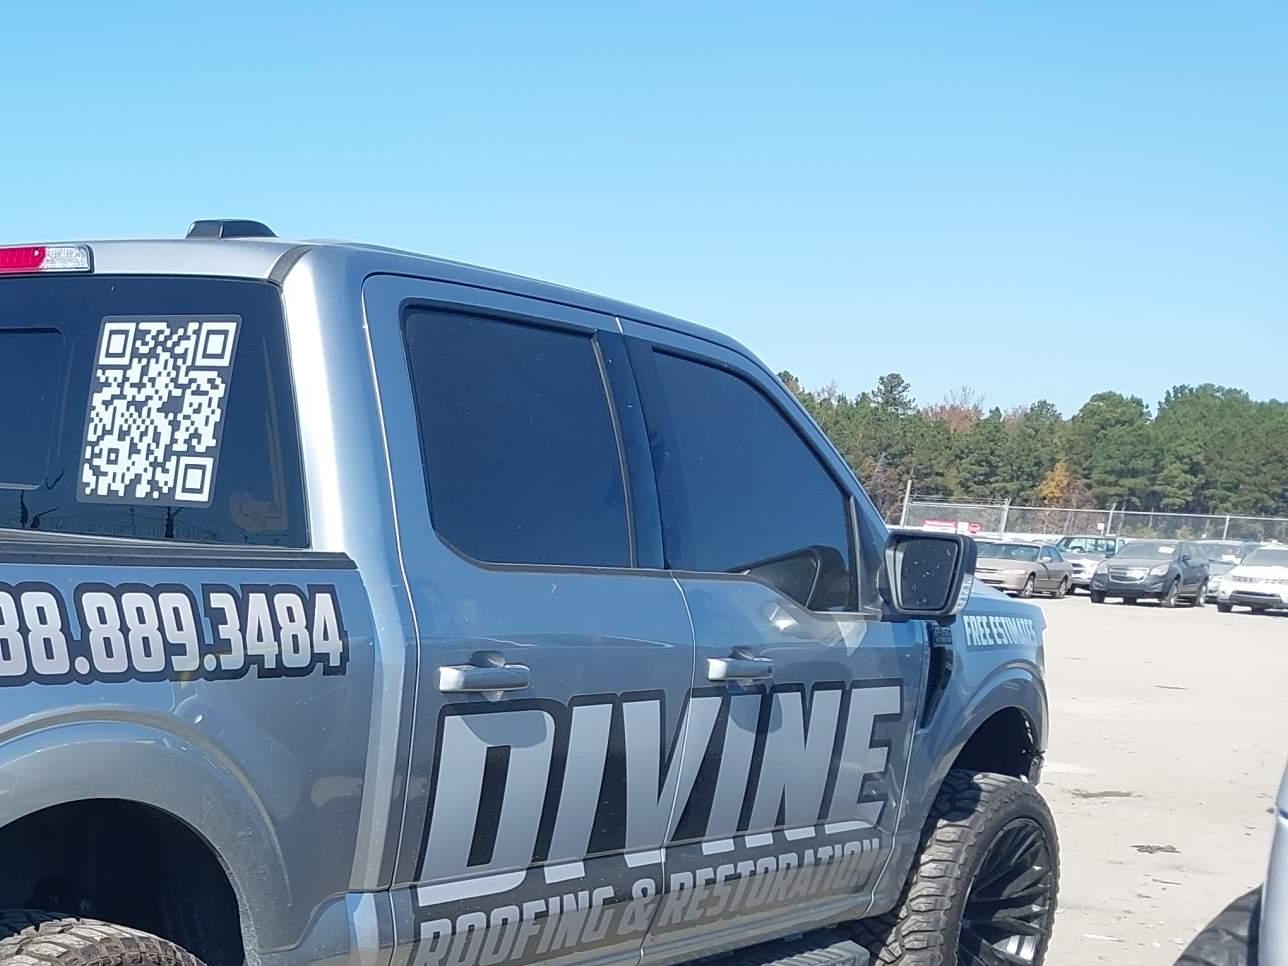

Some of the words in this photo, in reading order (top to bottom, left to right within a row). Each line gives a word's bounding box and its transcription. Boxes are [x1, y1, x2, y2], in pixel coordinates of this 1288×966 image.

[963, 615, 995, 646] FREE
[417, 685, 902, 907] DIVINE
[618, 878, 657, 936] &
[657, 838, 880, 927] RESTORATION
